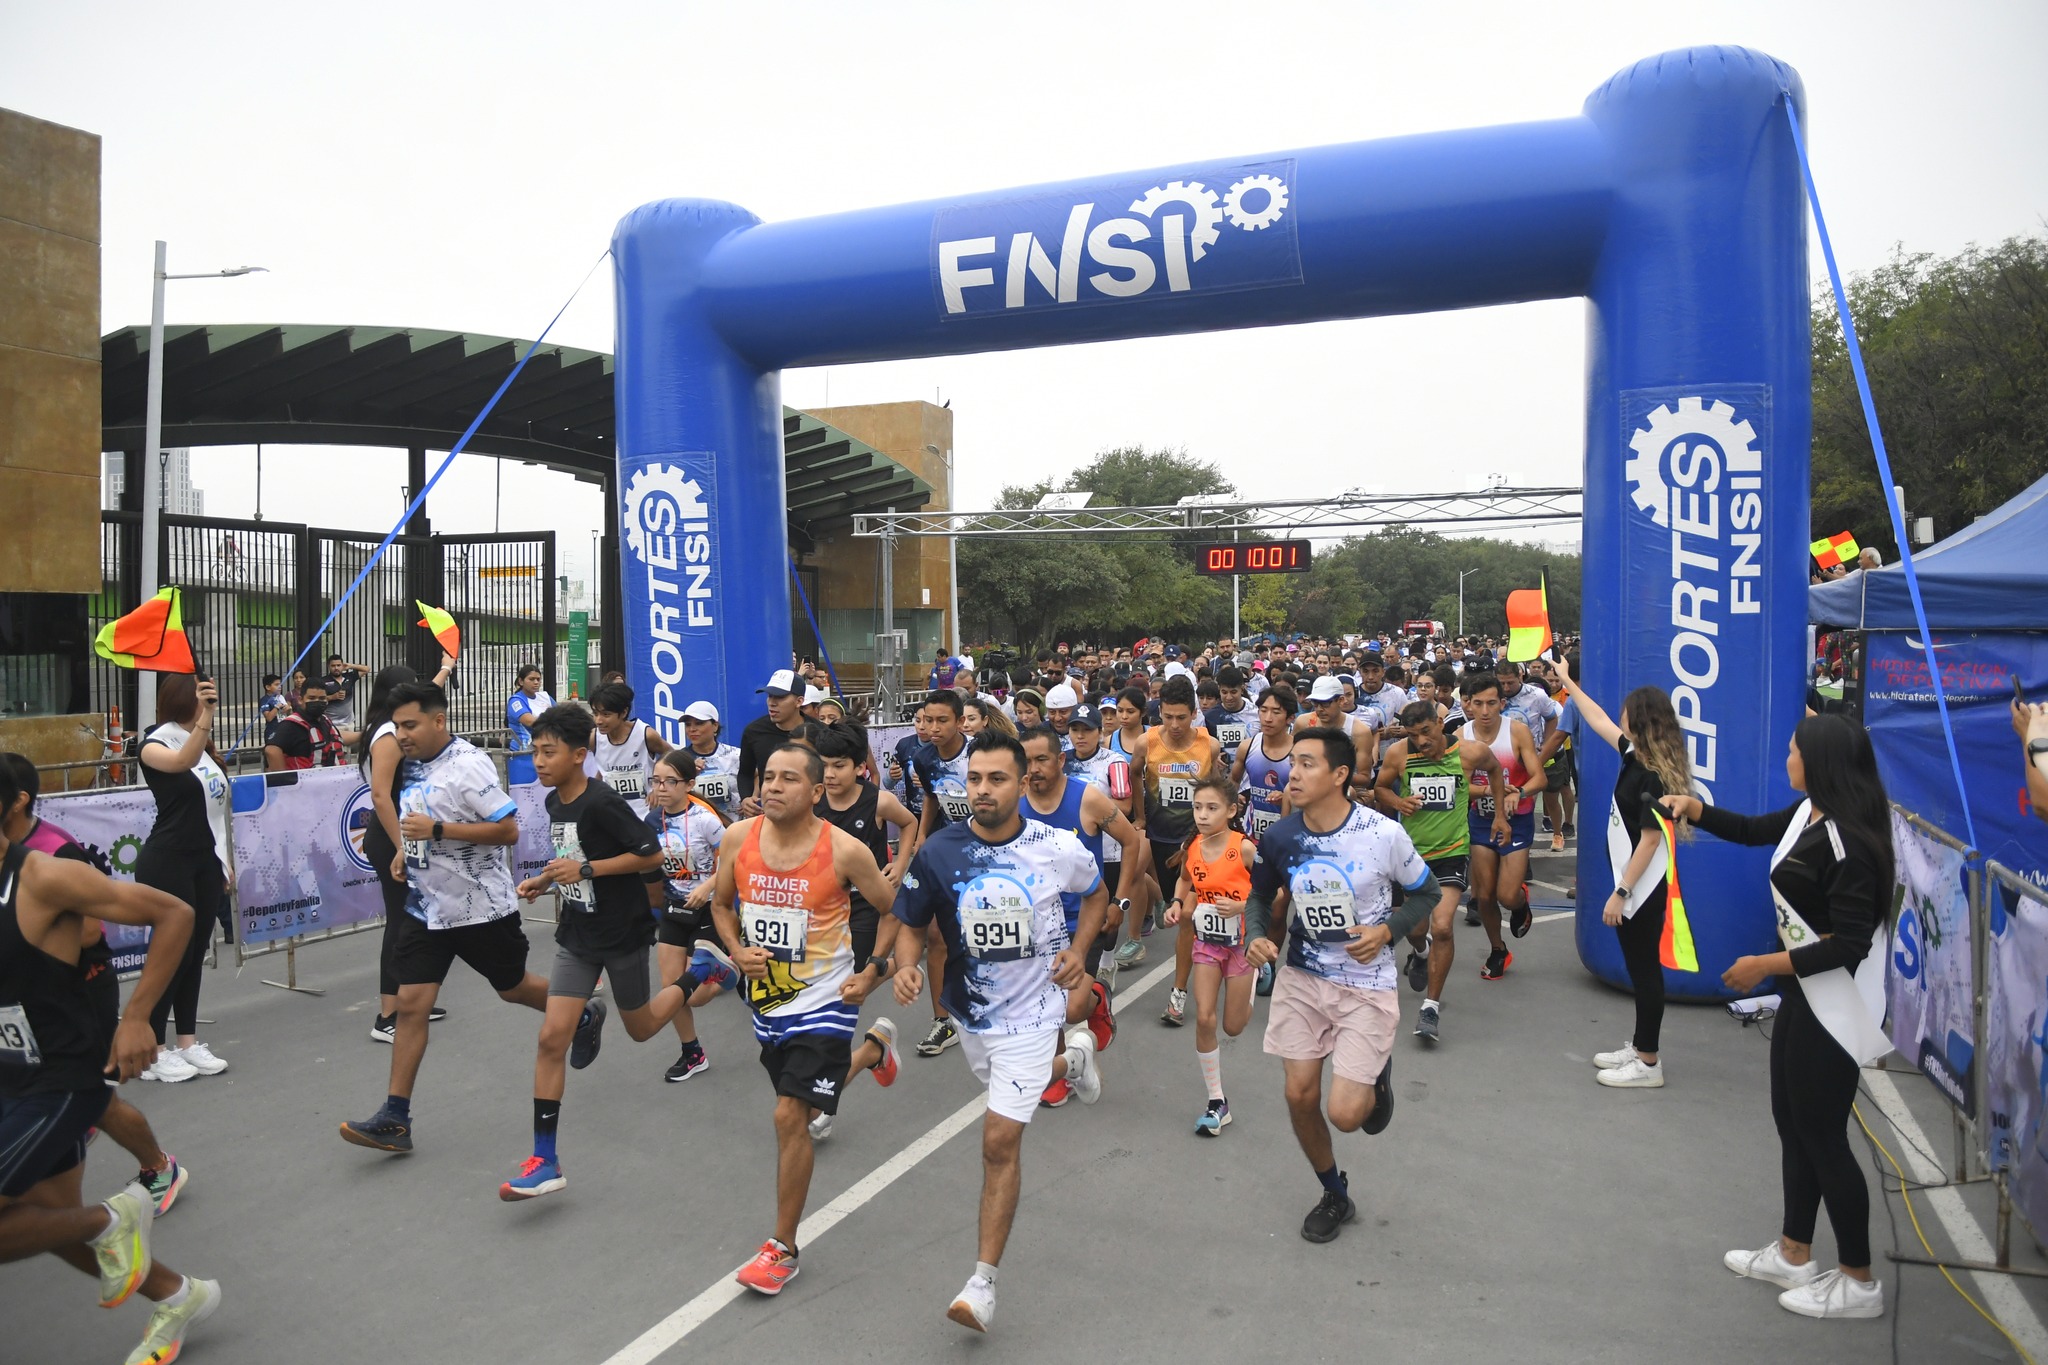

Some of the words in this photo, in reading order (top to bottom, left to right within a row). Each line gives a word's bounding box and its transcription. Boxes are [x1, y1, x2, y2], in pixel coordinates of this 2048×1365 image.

[939, 203, 1191, 313] FNSI
[1731, 476, 1762, 615] FNSI
[683, 522, 714, 627] FNSI
[643, 496, 688, 751] EPORTES
[1669, 441, 1721, 807] EPORTES
[1221, 730, 1241, 742] 588
[198, 766, 225, 799] NSI
[614, 778, 638, 793] 1211
[698, 781, 724, 797] 786
[1418, 785, 1447, 801] 390
[1168, 786, 1189, 801] 121
[947, 802, 970, 816] 210
[748, 873, 809, 893] PRIMER
[242, 896, 321, 917] #DeporteyFamilia
[1305, 905, 1346, 928] 665
[755, 919, 789, 946] 931
[973, 921, 1020, 946] 934
[1204, 913, 1227, 934] 311
[812, 1086, 835, 1096] adidas
